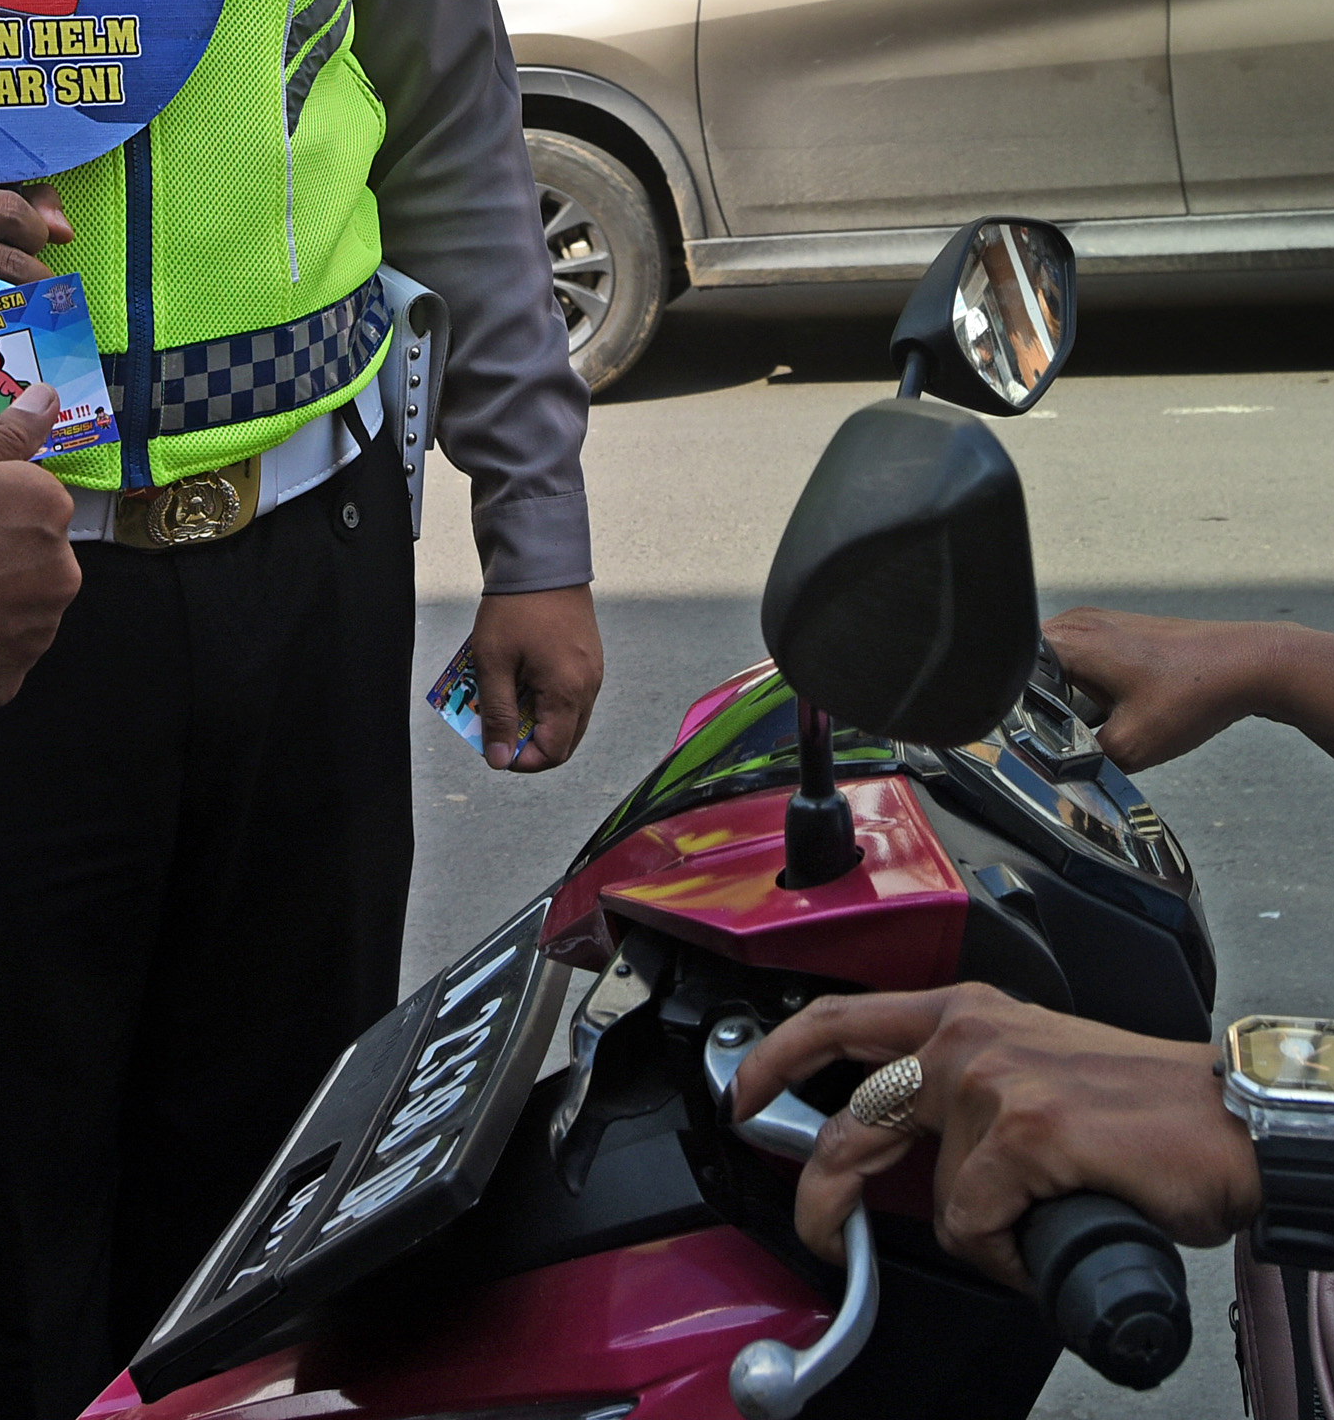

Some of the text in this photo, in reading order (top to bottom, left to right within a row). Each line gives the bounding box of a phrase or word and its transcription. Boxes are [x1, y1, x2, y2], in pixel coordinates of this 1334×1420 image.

[30, 16, 139, 57] HELM
[53, 64, 124, 105] SNI
[51, 421, 93, 439] PRESISI
[54, 408, 73, 424] NI
